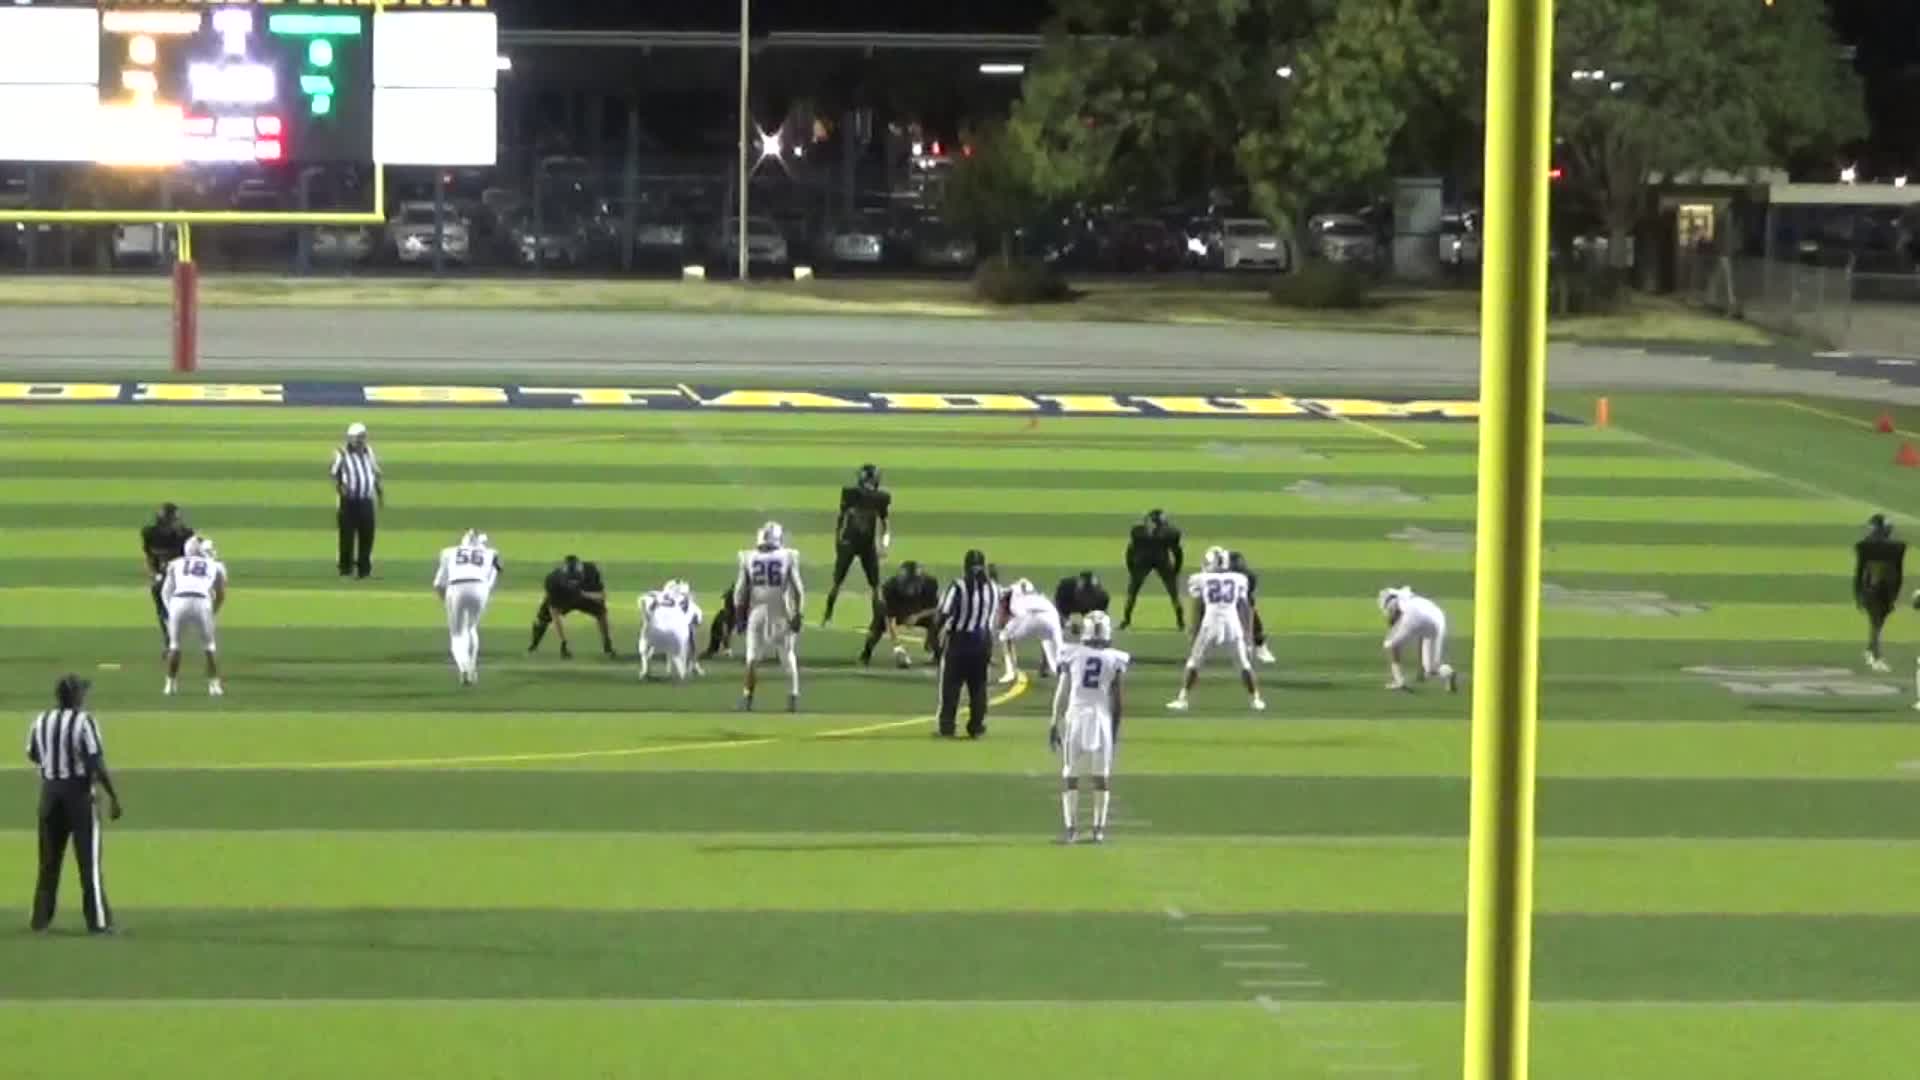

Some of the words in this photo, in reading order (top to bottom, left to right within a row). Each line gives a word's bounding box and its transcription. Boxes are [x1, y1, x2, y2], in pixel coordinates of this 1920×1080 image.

[183, 560, 208, 577] 18
[456, 548, 484, 567] 56
[752, 559, 783, 587] 26
[1207, 578, 1235, 604] 23
[1082, 656, 1103, 689] 2
